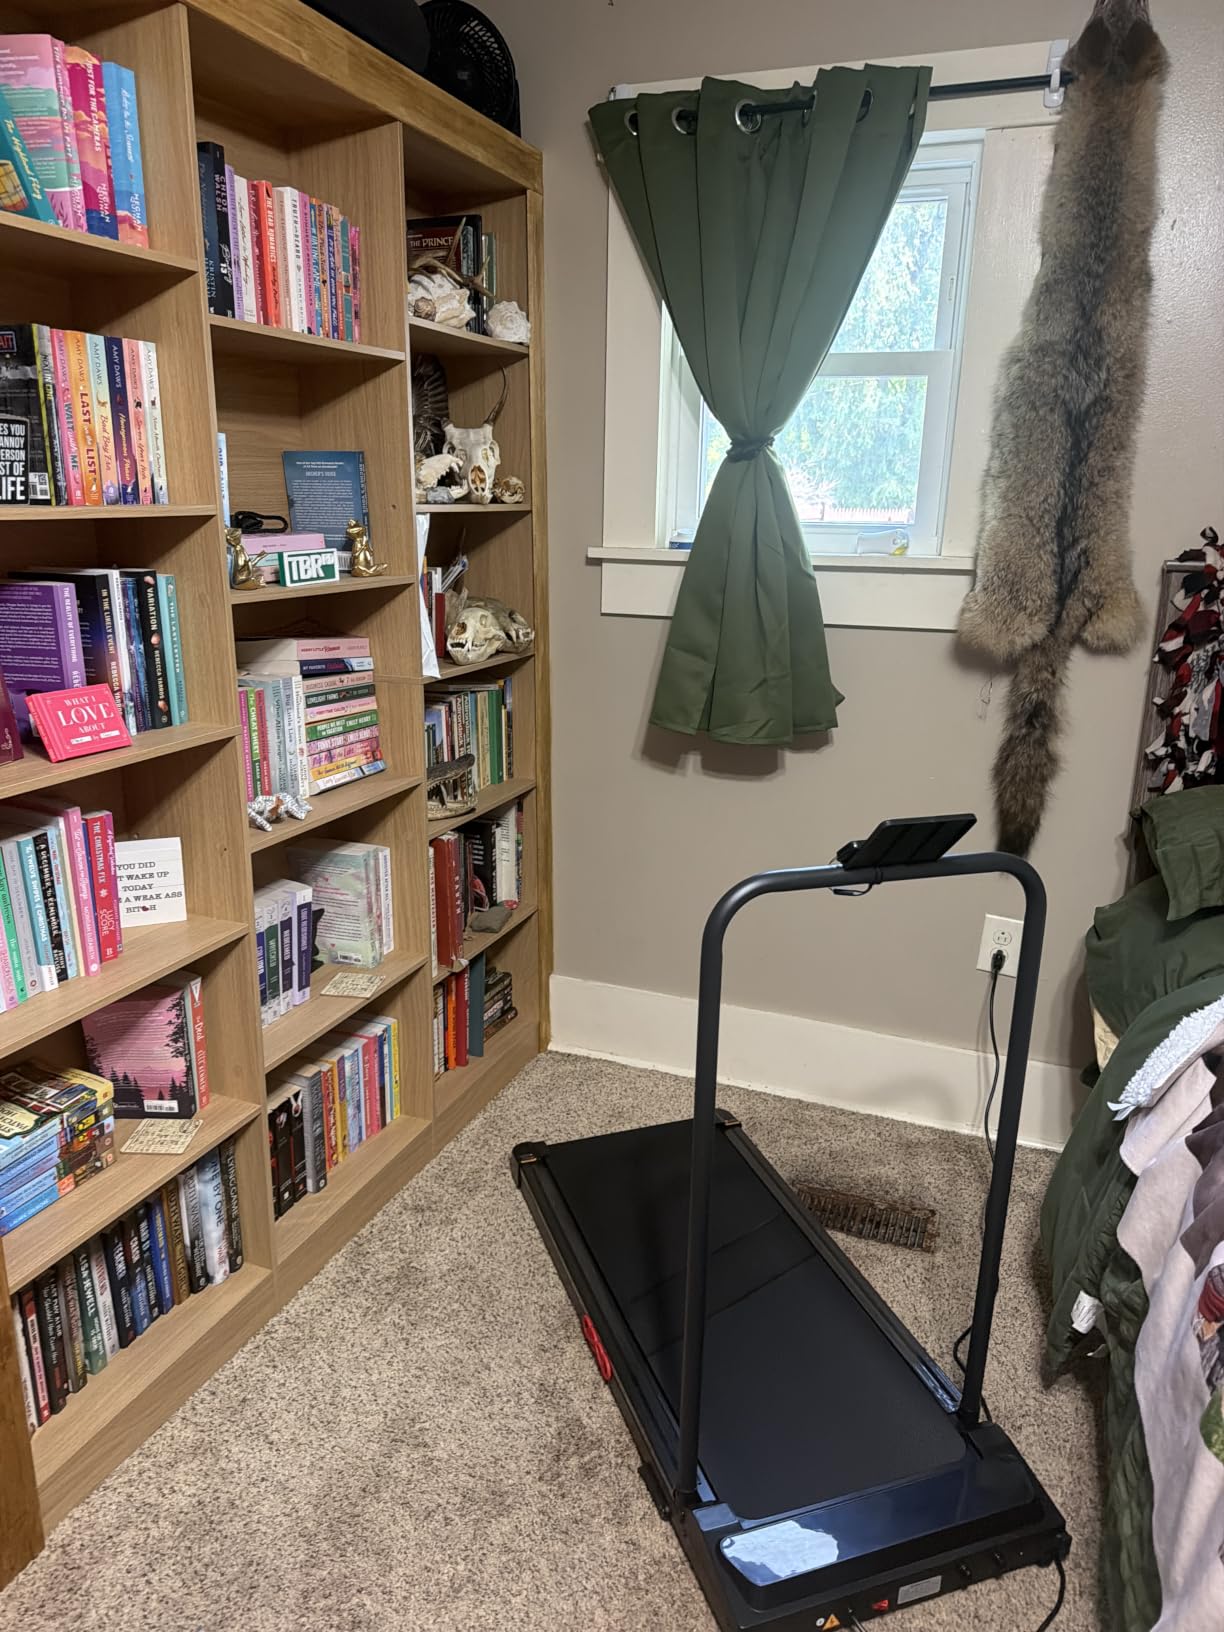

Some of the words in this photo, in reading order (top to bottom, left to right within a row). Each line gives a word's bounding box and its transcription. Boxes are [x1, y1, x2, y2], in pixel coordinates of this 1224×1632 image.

[85, 60, 94, 77] JUST
[87, 79, 95, 95] FOR
[89, 96, 97, 112] THE
[90, 112, 101, 152] CAMERAS
[3, 118, 15, 132] The
[25, 173, 45, 201] Fling
[100, 183, 110, 222] MEGHAN
[214, 173, 222, 210] WALSH
[219, 176, 228, 212] CHLOE
[132, 192, 143, 231] MEGHAN
[267, 228, 276, 262] ROMANTICS
[220, 242, 232, 285] Binding
[220, 262, 227, 273] 13
[207, 259, 216, 297] KRISTIN
[43, 372, 51, 382] IN
[59, 358, 67, 383] DAWS
[77, 358, 85, 383] DAWS
[94, 363, 102, 385] DAWS
[113, 365, 121, 387] DAWS
[147, 368, 155, 390] DAWS
[64, 401, 74, 431] WAIT
[100, 413, 109, 432] Bad
[10, 424, 26, 436] YOU
[67, 430, 76, 452] with
[79, 391, 90, 424] LAST
[85, 447, 96, 475] LIST
[101, 434, 111, 452] Boy
[13, 462, 25, 475] OF
[70, 453, 78, 471] ME
[288, 554, 324, 580] TBR
[62, 586, 70, 597] THE
[101, 588, 107, 596] IN
[64, 598, 72, 619] REALITY
[146, 587, 158, 630] VARIATION
[67, 620, 73, 628] OF
[103, 611, 112, 632] LIKELY
[170, 621, 178, 641] LAST
[67, 629, 78, 662] EVERYTHING
[106, 634, 114, 653] EVENT
[153, 650, 161, 676] REBECCA
[172, 644, 181, 673] LETTER
[109, 661, 120, 690] REBECCA
[64, 696, 88, 706] WHAT
[57, 702, 114, 726] LOVE
[357, 715, 371, 723] HENRY
[455, 697, 464, 745] Adirondack
[79, 722, 105, 734] ABOUT
[251, 732, 259, 753] SHEET
[92, 822, 101, 833] THE
[94, 836, 104, 870] CHRISTMAS
[27, 854, 36, 877] TWELVE
[126, 872, 154, 880] WAKE
[31, 880, 41, 900] SWIPES
[40, 851, 51, 887] DECEMBER
[46, 897, 58, 936] REMEMBER
[122, 884, 154, 892] TODAY
[133, 894, 162, 902] WEAK
[105, 909, 114, 931] LUCY
[126, 905, 156, 913] BITH
[36, 909, 48, 941] CHRISTMAS
[99, 908, 108, 936] SCORE
[226, 1155, 237, 1186] LYING
[184, 1175, 197, 1203] RUTH
[212, 1183, 222, 1197] BY
[213, 1199, 225, 1227] ONE
[228, 1186, 240, 1218] GAME
[189, 1203, 201, 1232] WARE
[113, 1242, 127, 1279] TEACHER
[129, 1236, 141, 1263] CRASH
[78, 1253, 89, 1277] LISA
[82, 1278, 95, 1316] JEWELL
